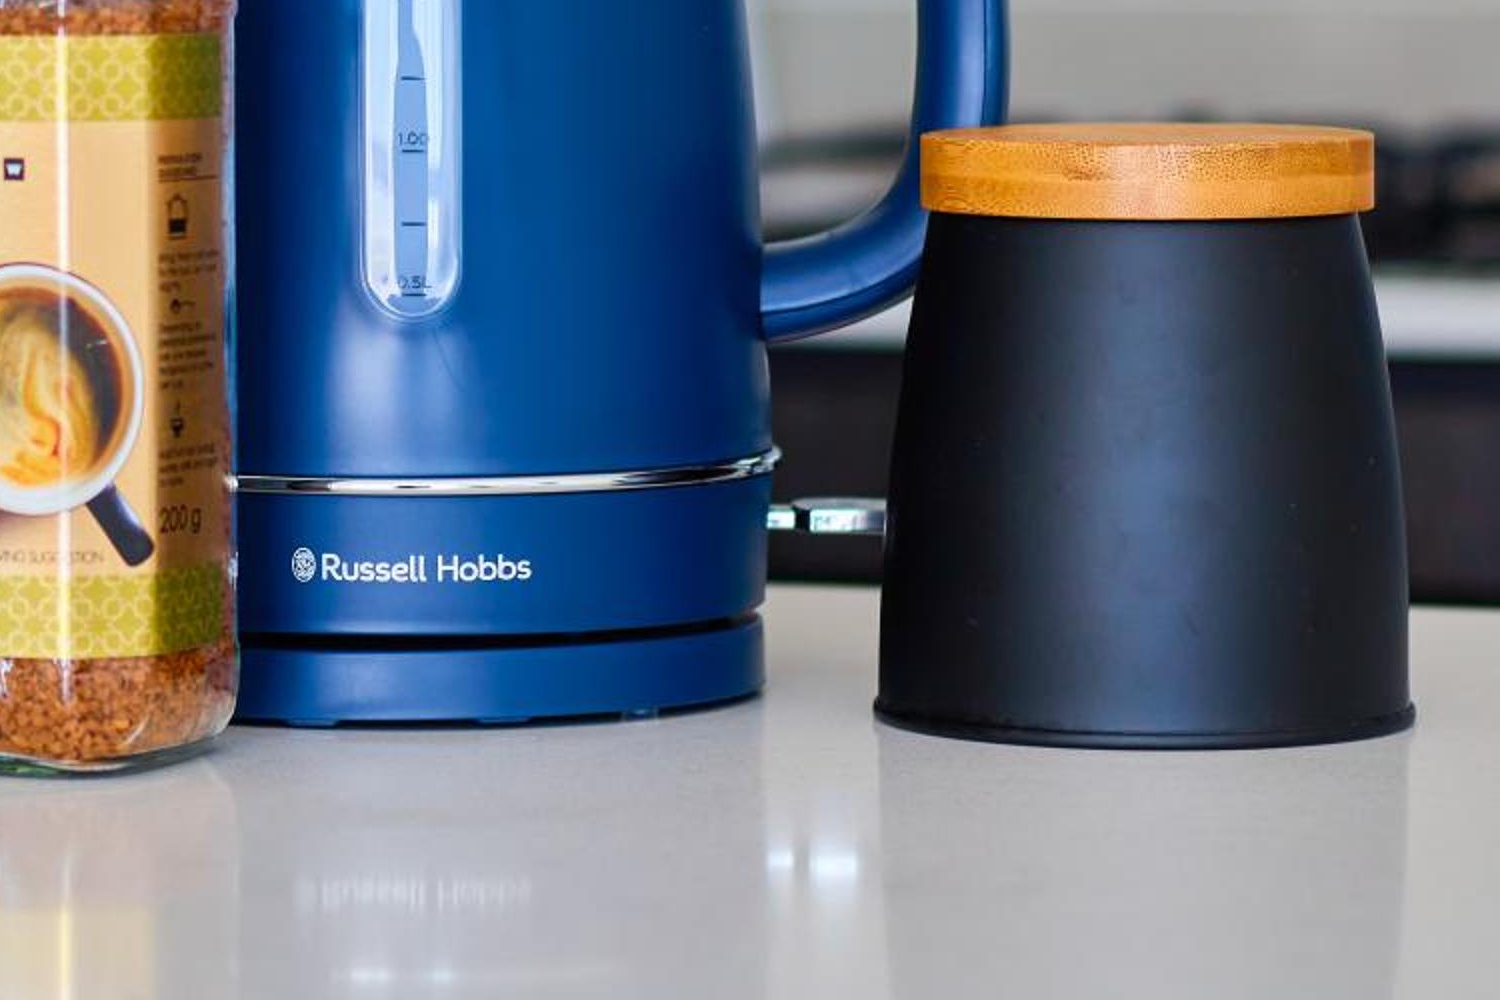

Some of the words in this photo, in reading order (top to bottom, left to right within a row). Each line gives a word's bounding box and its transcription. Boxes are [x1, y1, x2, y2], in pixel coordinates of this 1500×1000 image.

[158, 504, 189, 535] 200
[190, 507, 202, 535] g
[321, 552, 427, 582] Russell
[436, 553, 533, 583] Hobbs
